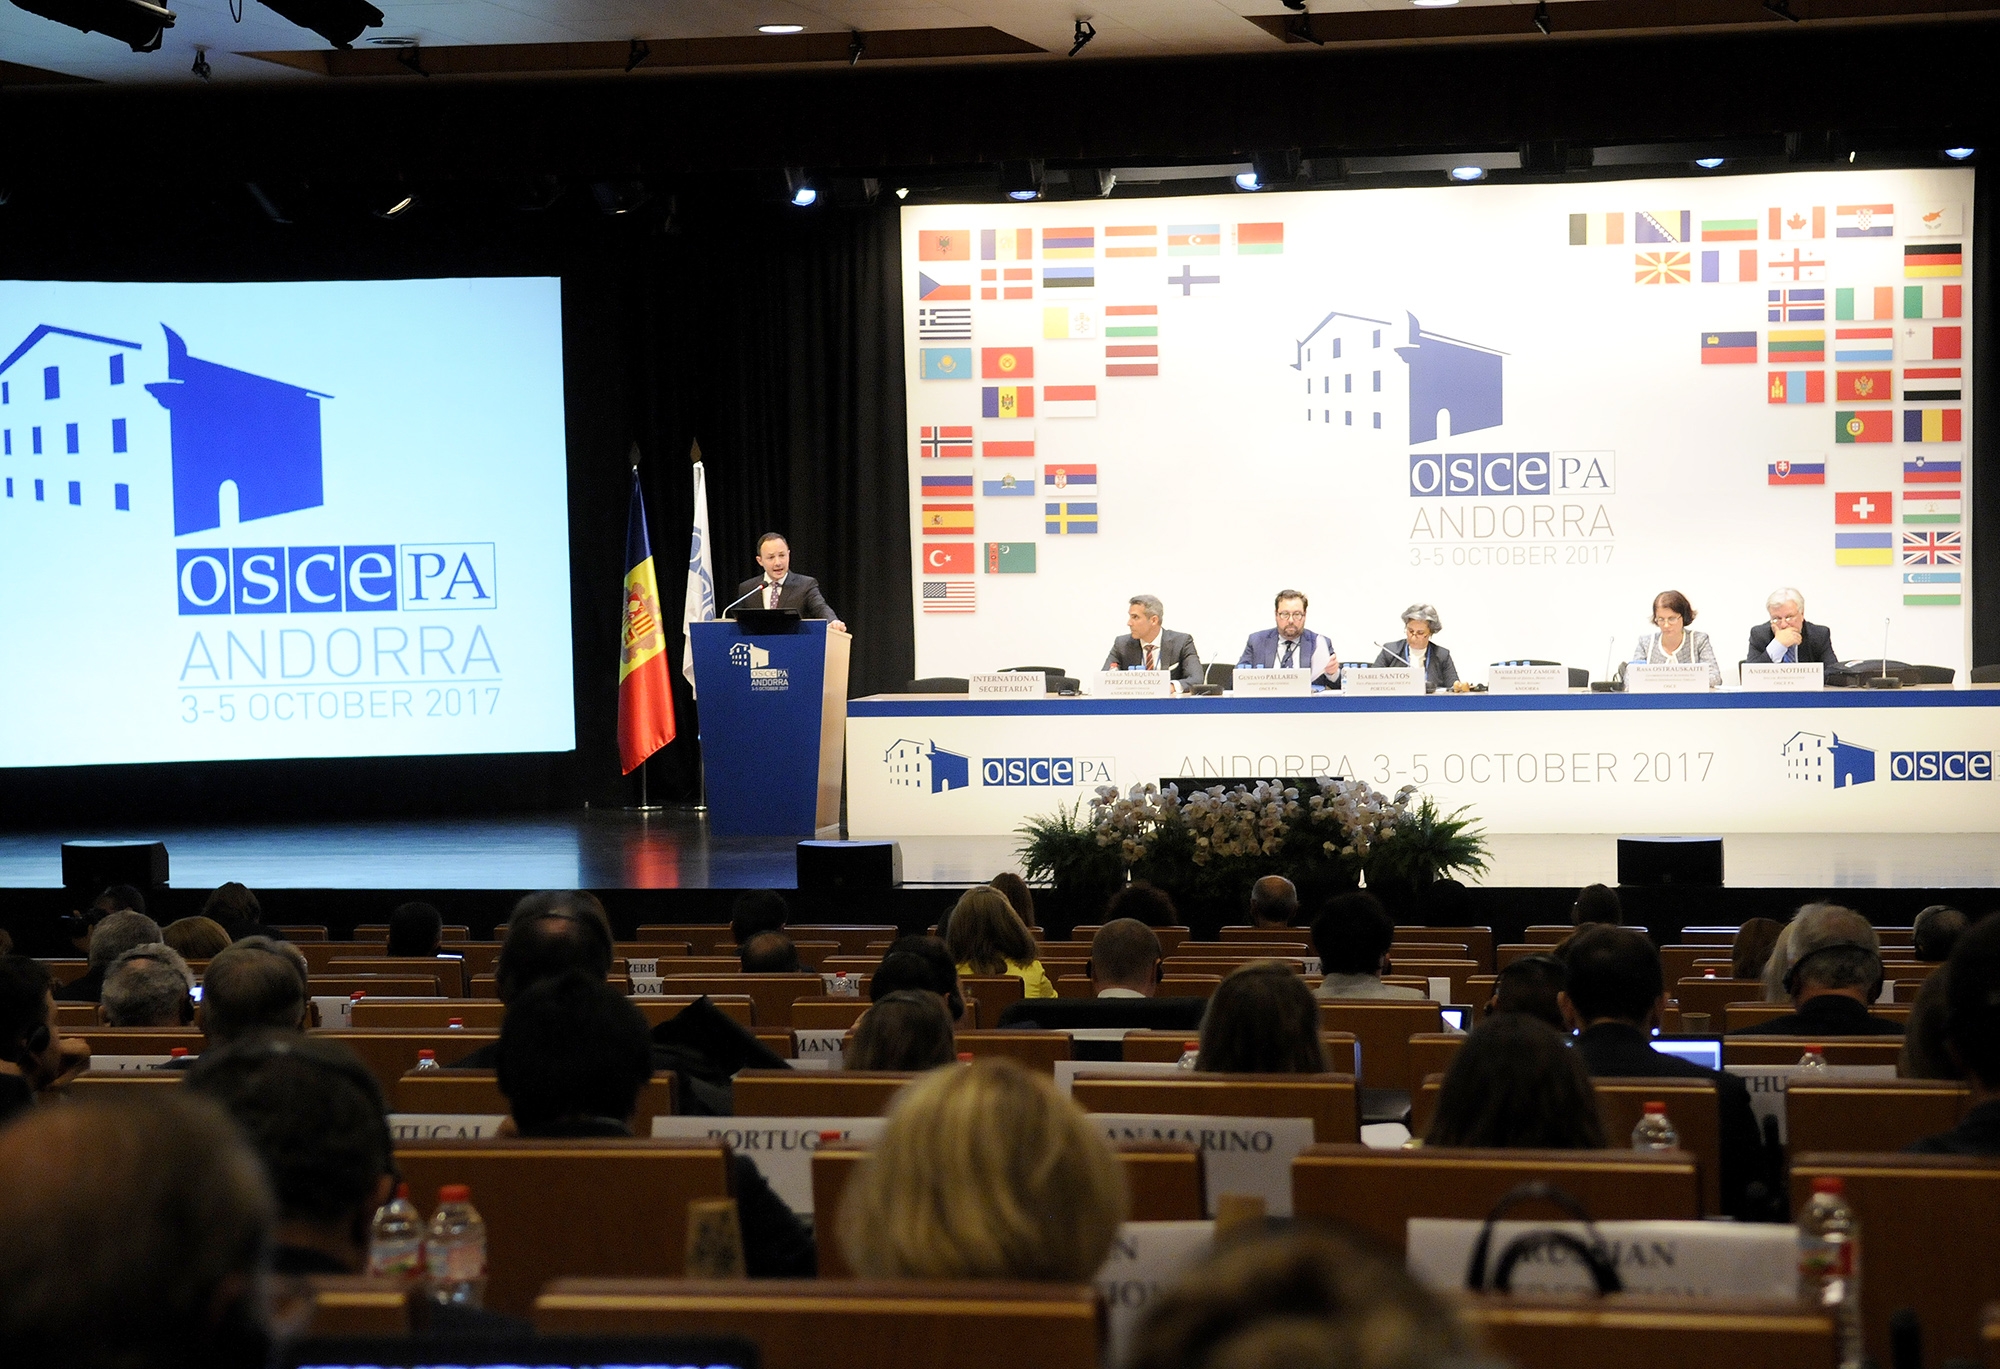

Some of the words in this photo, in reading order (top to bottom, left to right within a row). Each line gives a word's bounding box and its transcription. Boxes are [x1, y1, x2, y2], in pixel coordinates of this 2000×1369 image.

[1557, 457, 1610, 489] PA
[1409, 503, 1615, 539] ANDORRA
[1410, 547, 1445, 566] 3-5
[1452, 545, 1557, 566] OCTOBER
[1564, 545, 1615, 565] 2017
[407, 551, 491, 601] PA
[179, 624, 501, 681] ANDORRA
[750, 678, 789, 686] ANDORRA
[979, 685, 1034, 693] SECRETARIAT
[181, 693, 236, 723] 3-5
[248, 689, 414, 721] OCTOBER
[426, 687, 501, 717] 2017
[1078, 760, 1113, 782] PA
[1178, 754, 1357, 782] ANDORRA
[1373, 753, 1430, 784] 3-5
[1443, 753, 1618, 784] OCTOBER
[1632, 752, 1715, 783] 2017
